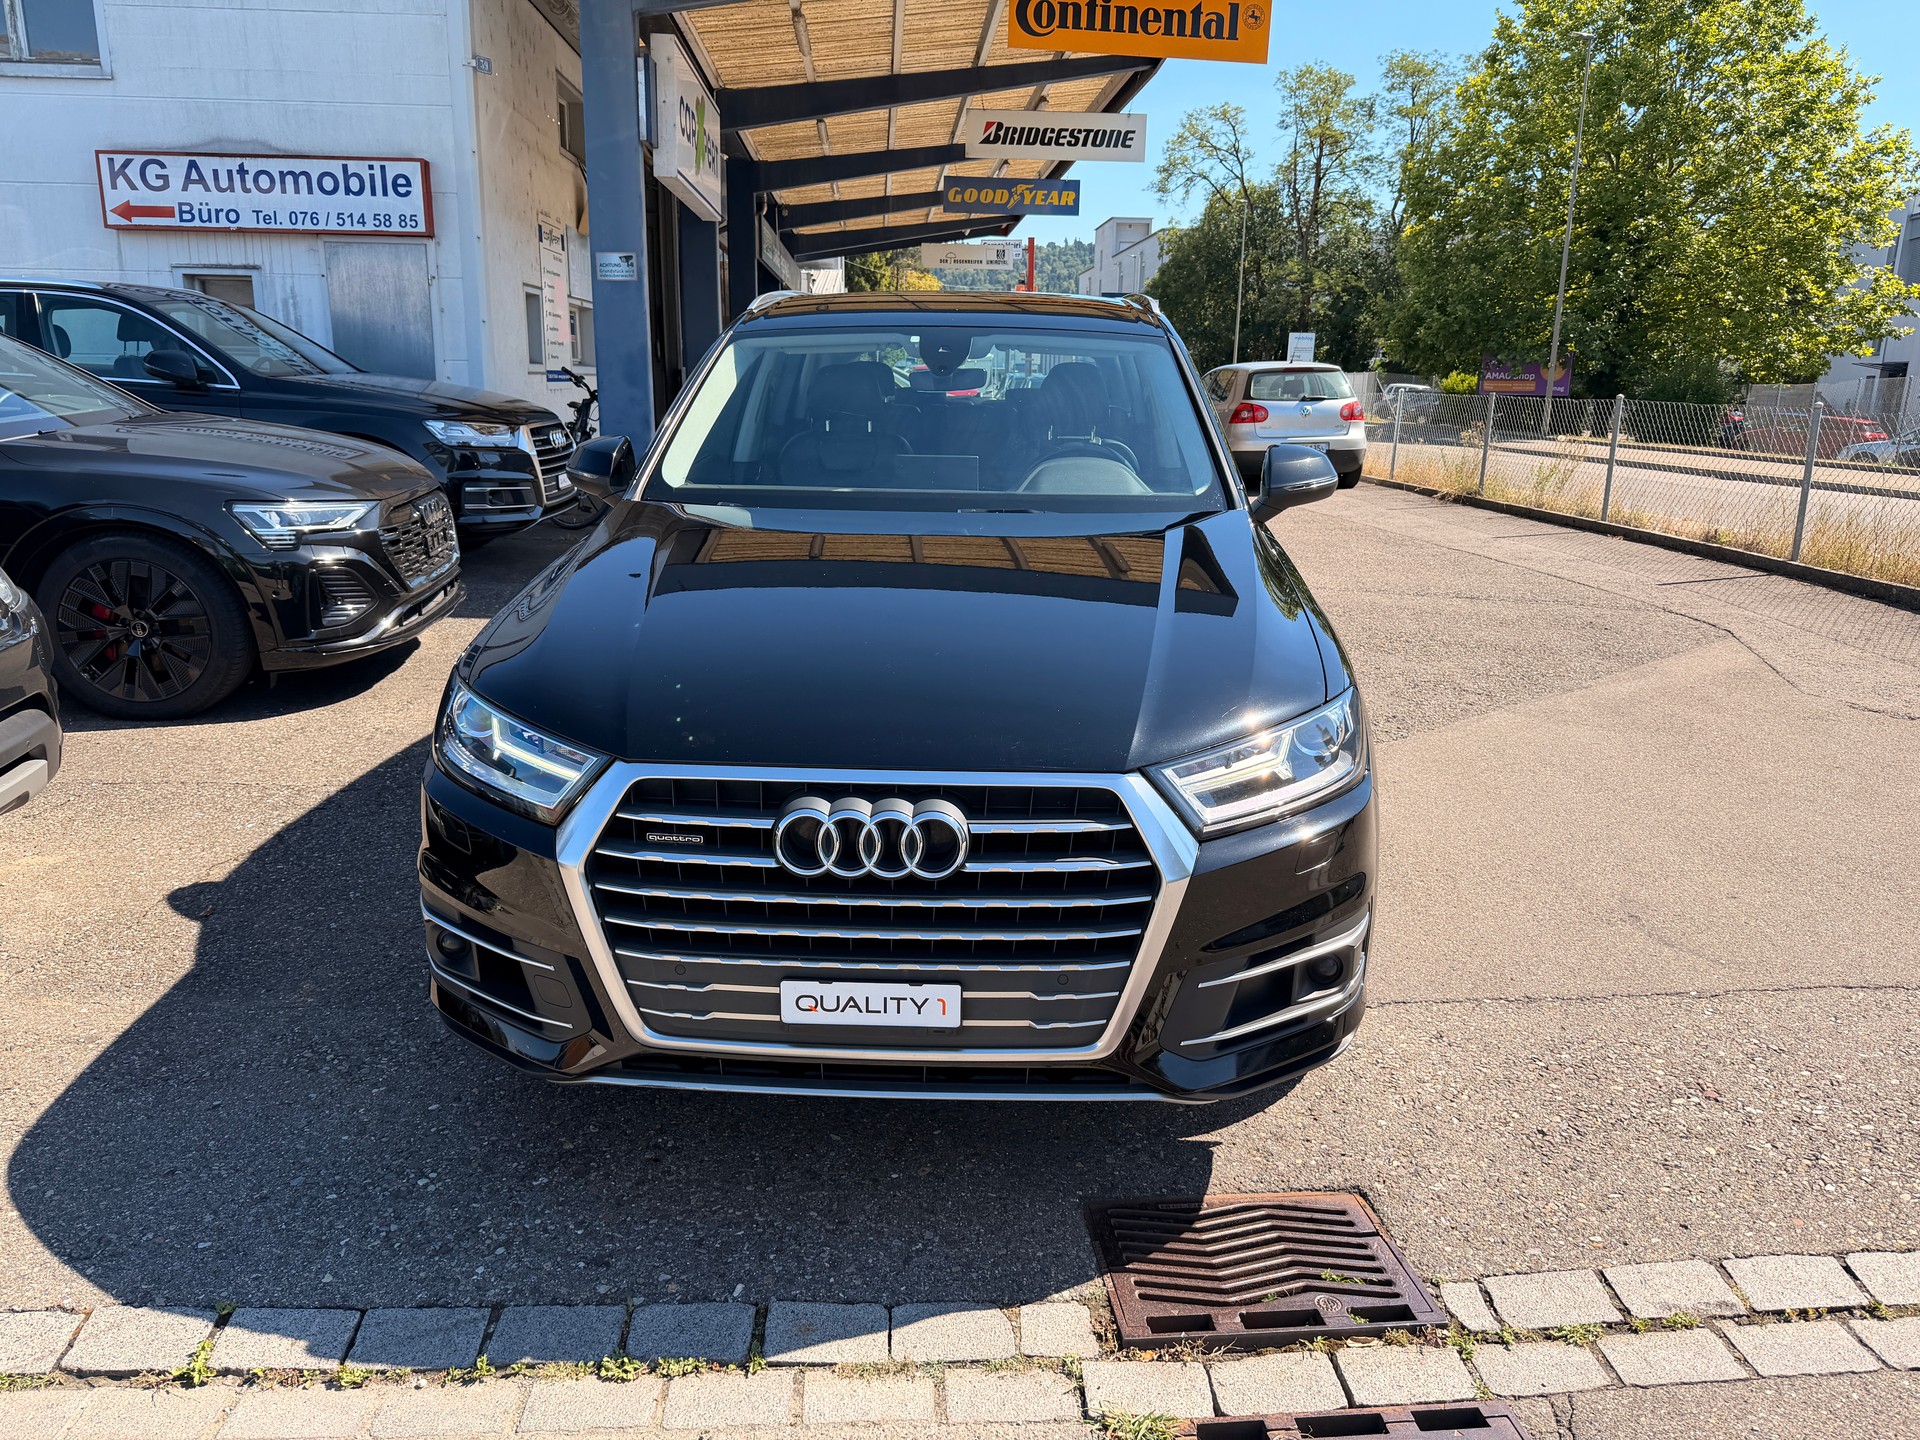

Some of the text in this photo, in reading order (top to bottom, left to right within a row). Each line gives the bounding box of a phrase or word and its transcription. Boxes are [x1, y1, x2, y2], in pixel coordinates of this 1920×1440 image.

[1016, 0, 1239, 41] Continental
[979, 121, 1136, 149] BRIDGESTONE
[107, 157, 413, 198] KG Automobile
[177, 202, 241, 225] Büro
[251, 210, 284, 226] Tel.
[288, 211, 320, 226] 076
[336, 212, 367, 228] 514
[373, 213, 393, 229] 58
[398, 214, 419, 229] 85
[795, 994, 947, 1016] QUALITY 1
